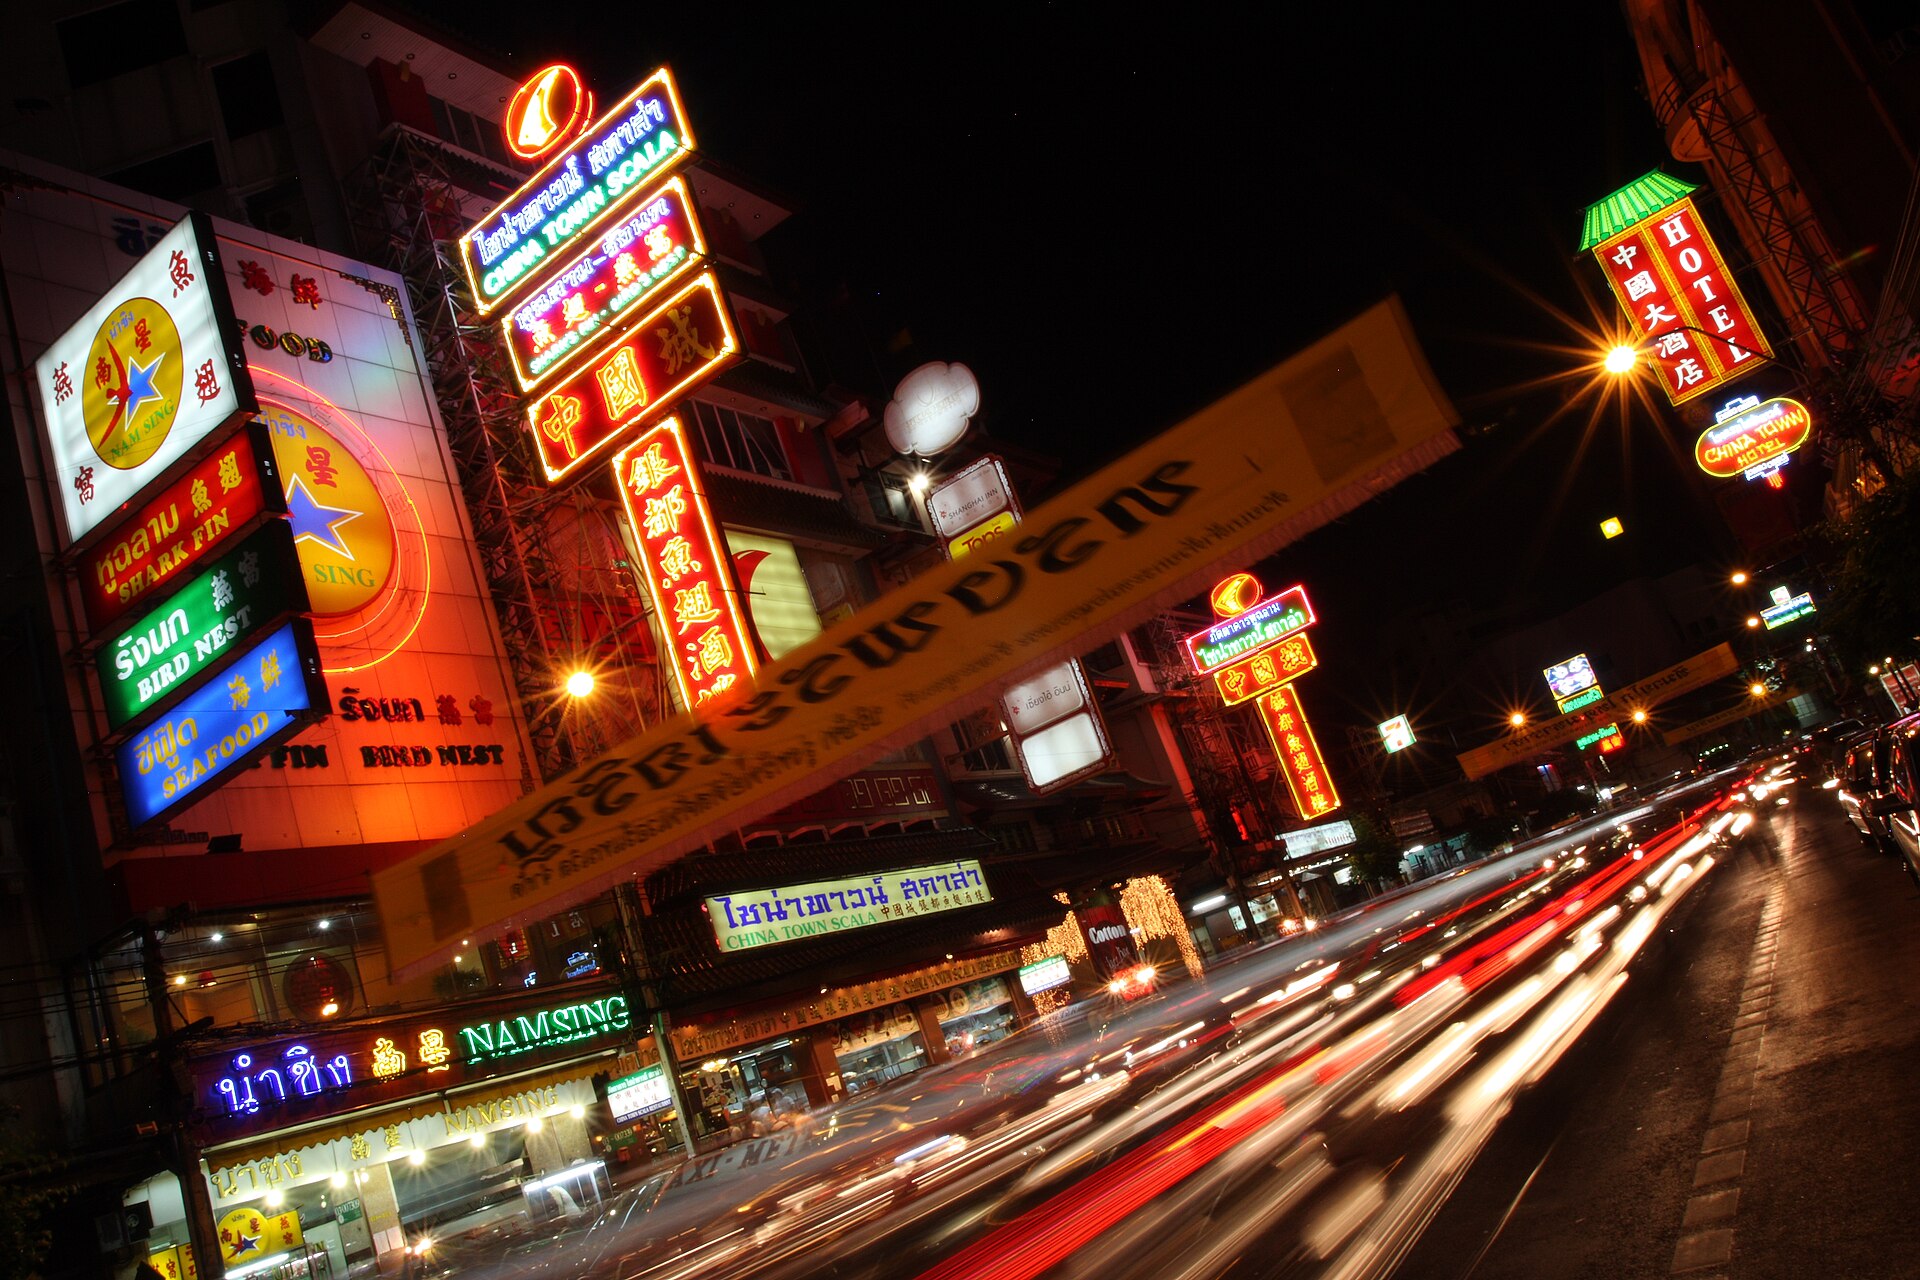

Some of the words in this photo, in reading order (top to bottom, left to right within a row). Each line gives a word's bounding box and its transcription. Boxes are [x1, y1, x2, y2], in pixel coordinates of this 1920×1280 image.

[483, 238, 545, 296] CHINA
[542, 184, 606, 244] TOWN
[606, 130, 677, 196] SCALA
[1612, 244, 1703, 390] 中國大酒店
[1660, 216, 1751, 364] HOTEL
[237, 319, 333, 364] OOD
[542, 305, 716, 459] 中國城
[111, 430, 142, 462] NAM
[143, 400, 175, 432] SING
[1704, 433, 1757, 463] CHINA
[1754, 409, 1804, 439] TOWN
[1737, 437, 1786, 467] HOTEL
[190, 450, 243, 519] 魚翅
[948, 495, 987, 520] SHANGHAI
[986, 486, 999, 500] INN
[118, 540, 189, 604] SHARK
[191, 507, 230, 551] FIN
[313, 564, 376, 588] SING
[114, 608, 190, 681] รังนก
[137, 651, 191, 703] BIRD
[197, 604, 252, 662] NEST
[1224, 641, 1308, 696] 中國城
[227, 648, 283, 712] 海鮮
[162, 711, 270, 800] SEAFOOD
[270, 743, 330, 769] FIN
[360, 745, 433, 768] BIRD
[438, 744, 504, 767] NEST
[713, 876, 889, 929] ไชน่าทาวน์
[900, 863, 983, 900] สกาล่า
[725, 930, 779, 950] CHINA
[783, 920, 828, 939] TOWN
[831, 911, 877, 930] SCALA
[1088, 924, 1127, 944] Cotton
[371, 1029, 451, 1081] 南星
[461, 996, 630, 1064] NAMSING
[445, 1088, 559, 1137] NAMSING
